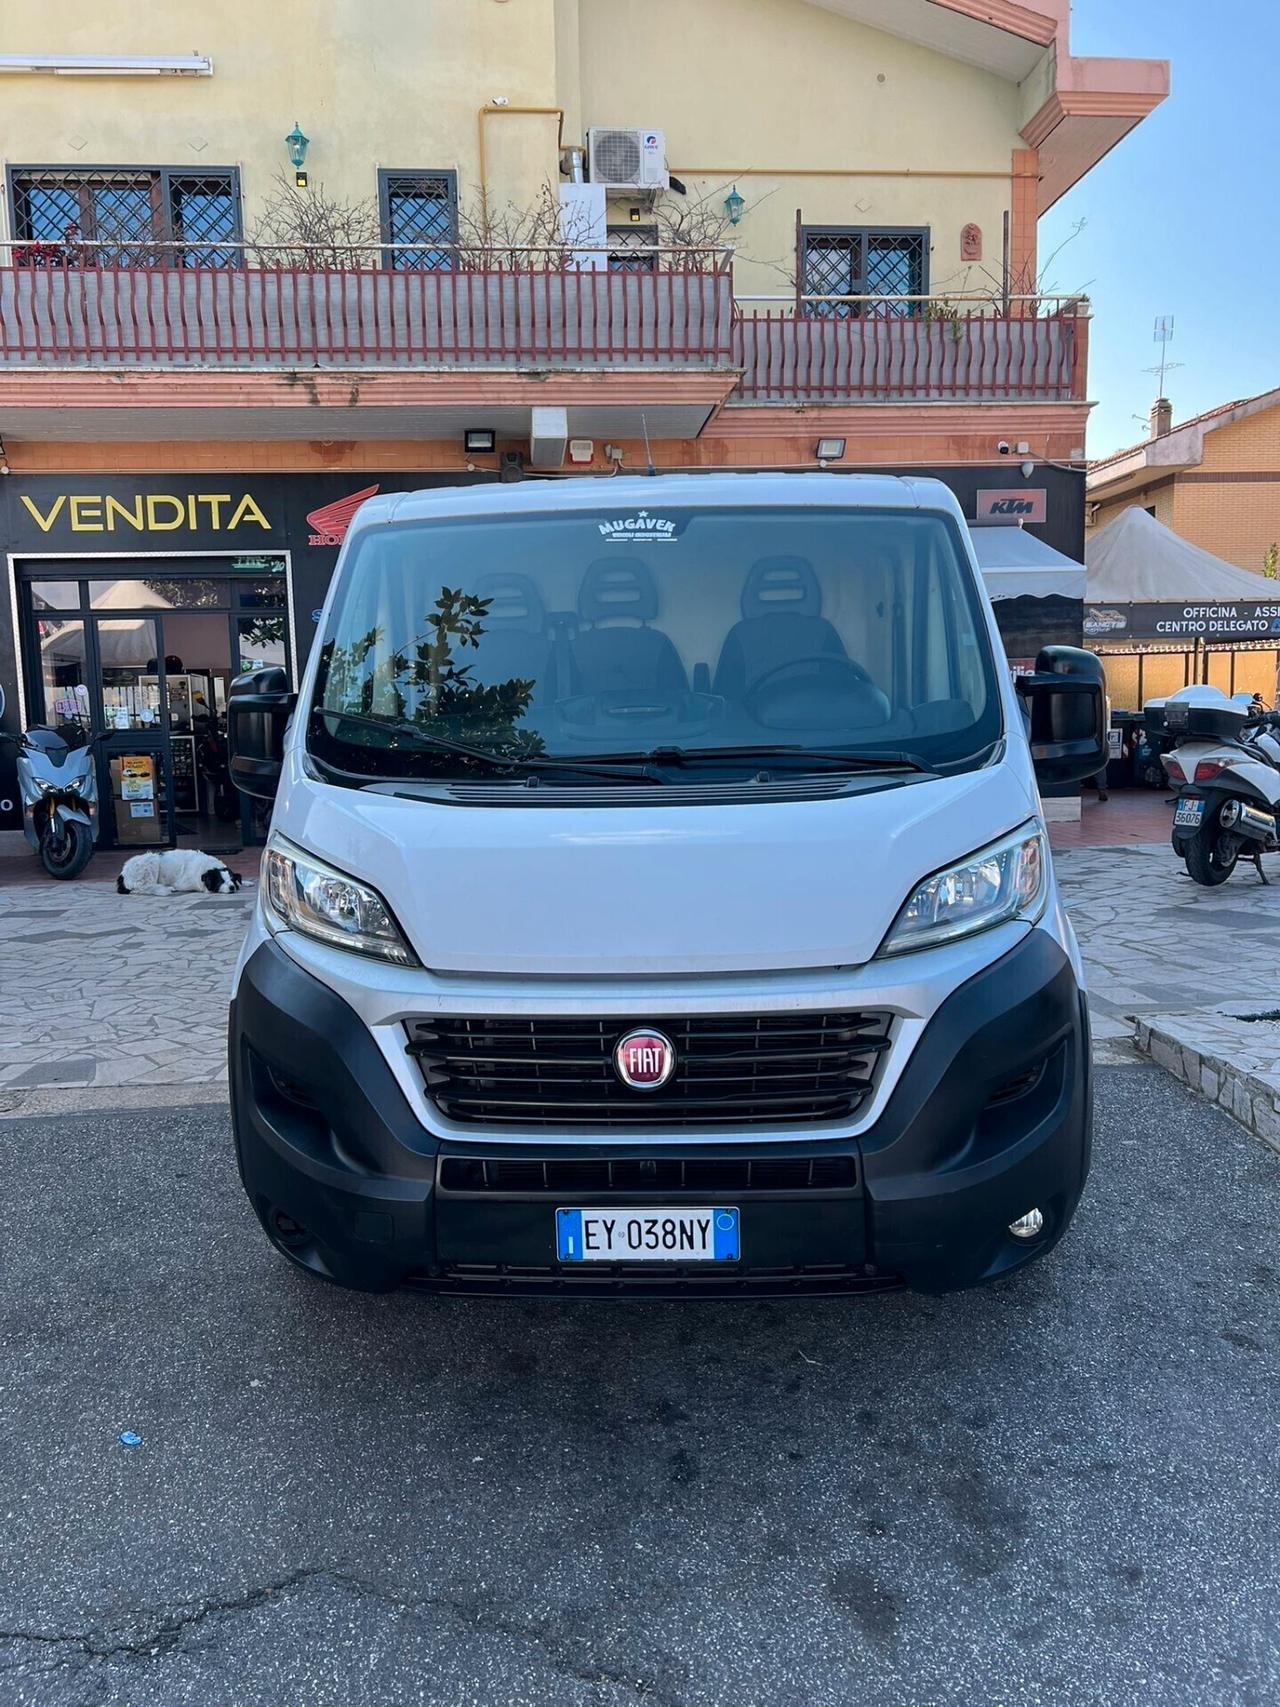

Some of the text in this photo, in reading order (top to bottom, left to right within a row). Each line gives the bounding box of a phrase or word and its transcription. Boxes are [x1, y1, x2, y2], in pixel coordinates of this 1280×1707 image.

[20, 494, 272, 531] VENDITA
[990, 498, 1034, 514] KTM
[1183, 607, 1238, 619] OFFICINA
[1254, 606, 1280, 617] ASSI
[1156, 620, 1269, 633] CENTRO DELEGATO
[629, 1047, 662, 1073] FIAT
[584, 1219, 711, 1250] EY 038NY
